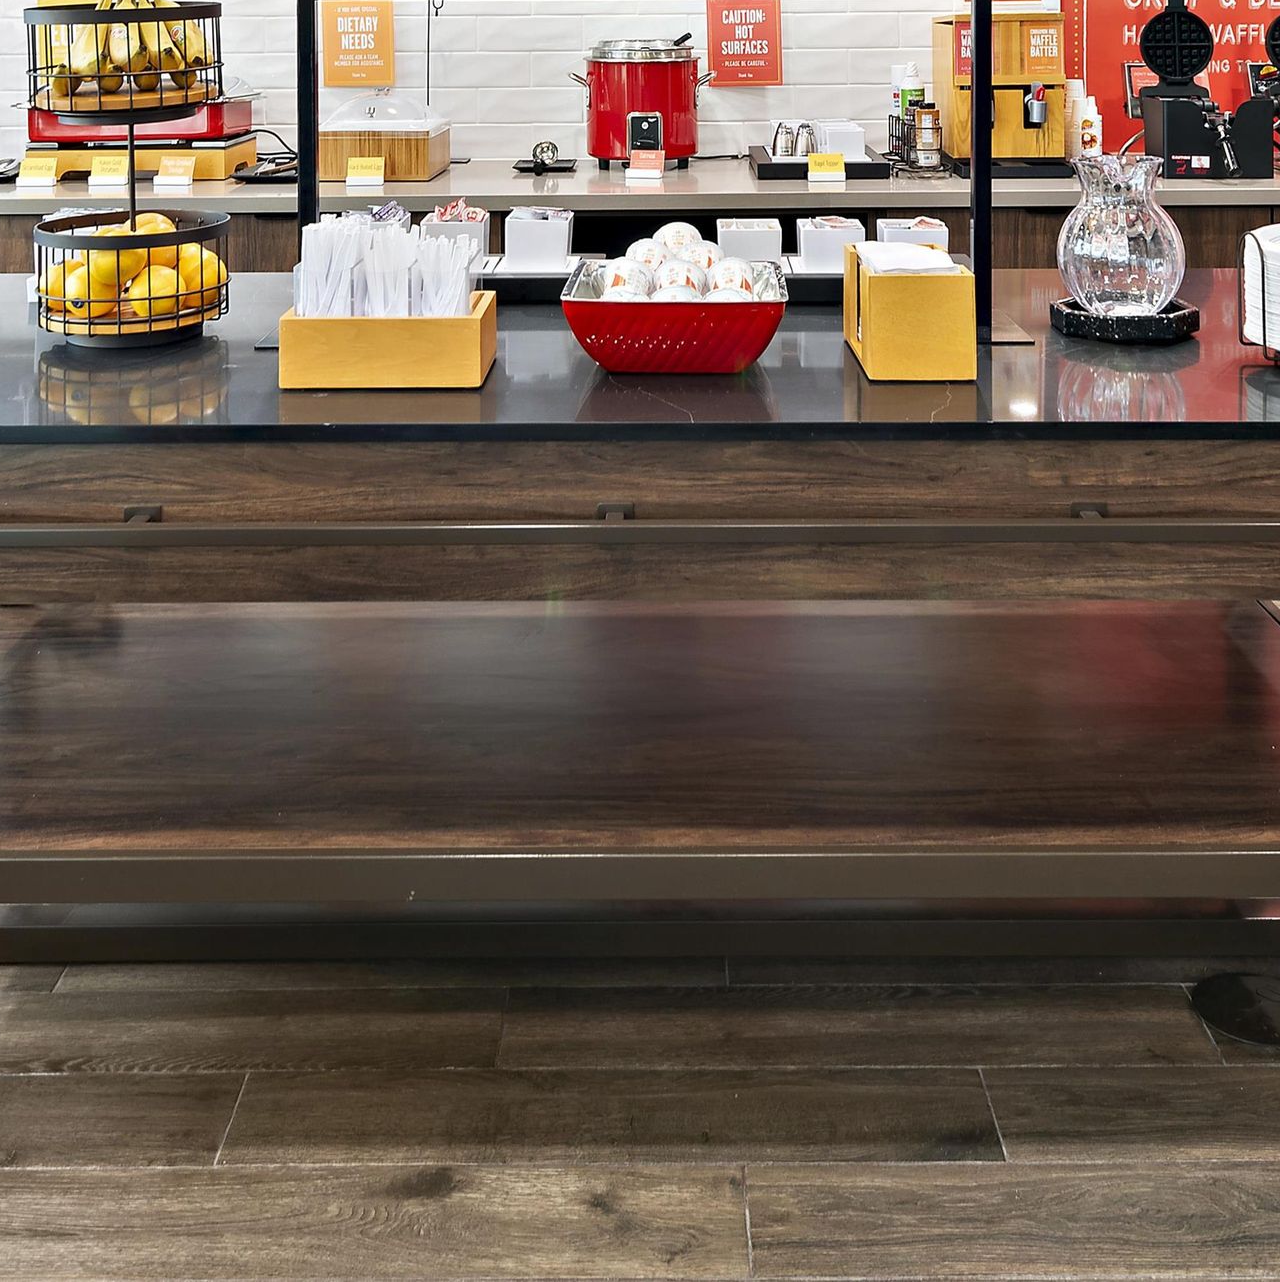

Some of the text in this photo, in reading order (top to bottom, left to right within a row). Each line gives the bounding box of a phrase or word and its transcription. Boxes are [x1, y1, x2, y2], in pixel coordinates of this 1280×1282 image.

[722, 9, 766, 24] CAUTION:
[337, 16, 378, 33] DIETARY
[735, 25, 754, 39] HOT
[341, 33, 375, 50] NEEDS
[1030, 35, 1058, 46] WAFFLE
[1208, 24, 1266, 46] AFFL
[721, 40, 769, 55] SURFACES
[1030, 46, 1058, 58] BATTER
[1207, 59, 1231, 73] ING
